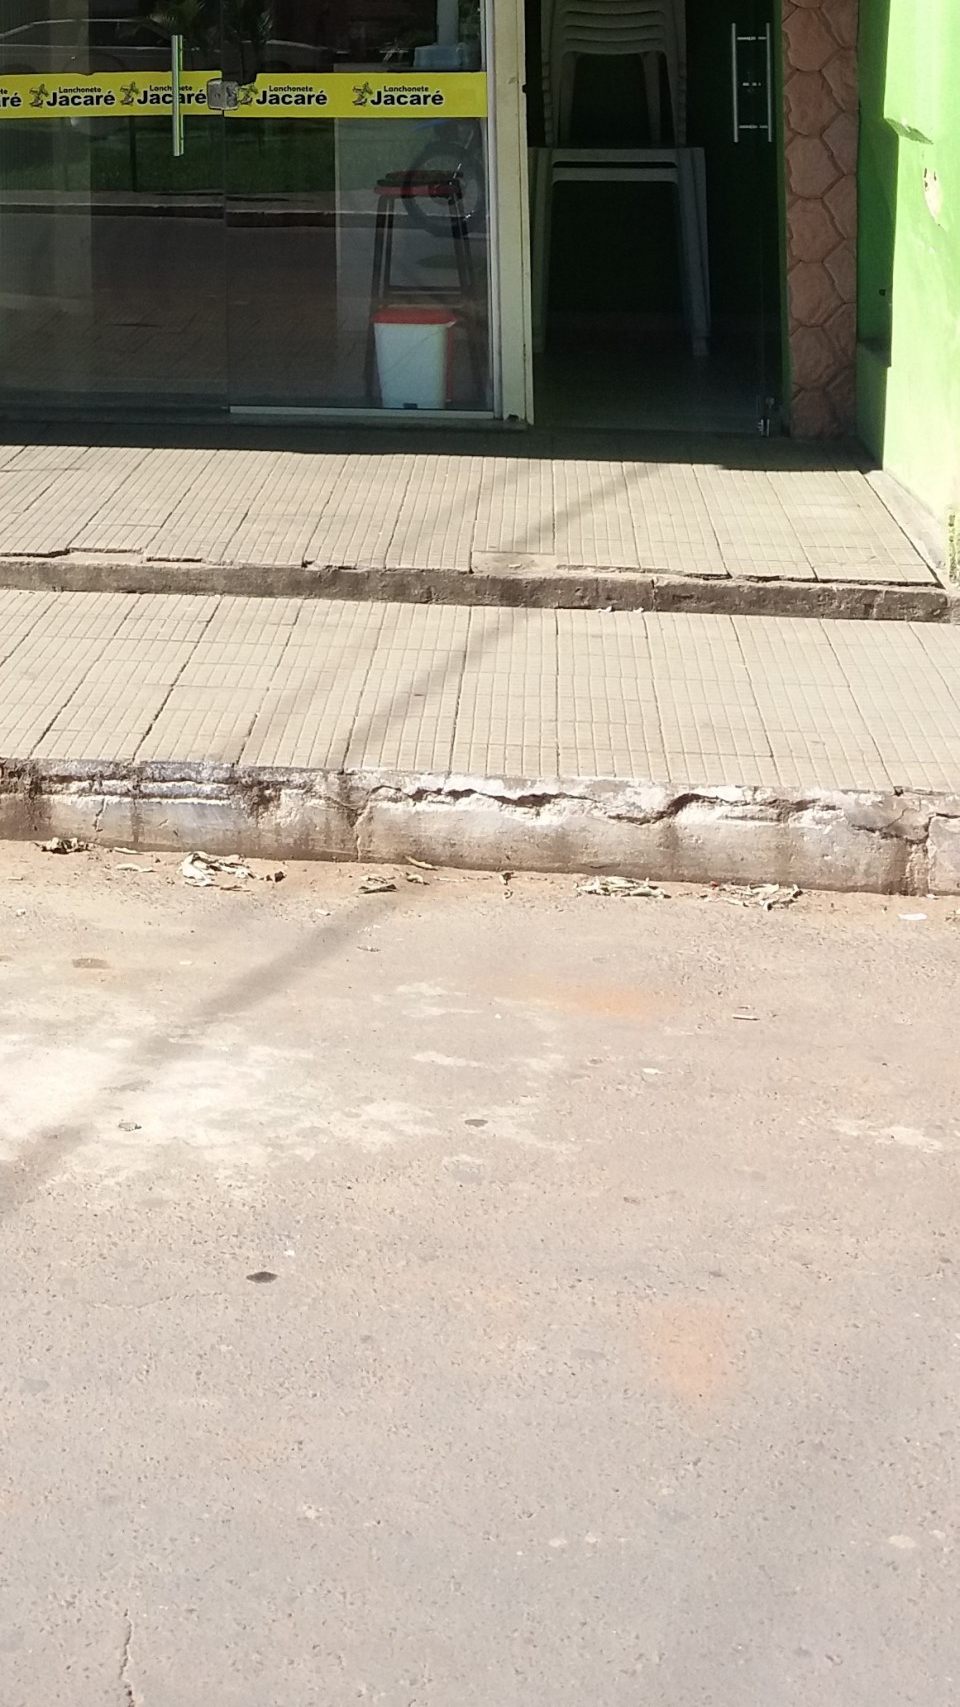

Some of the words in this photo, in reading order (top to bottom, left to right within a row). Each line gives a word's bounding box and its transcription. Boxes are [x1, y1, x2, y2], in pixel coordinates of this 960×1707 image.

[58, 86, 102, 94] Lanchonete
[149, 84, 193, 92] Lanchete
[268, 85, 314, 93] Lanchonete
[383, 85, 429, 93] Lanchonete
[46, 90, 116, 107] Jacaré
[256, 89, 328, 106] Jacaré
[370, 89, 445, 106] Jacaré
